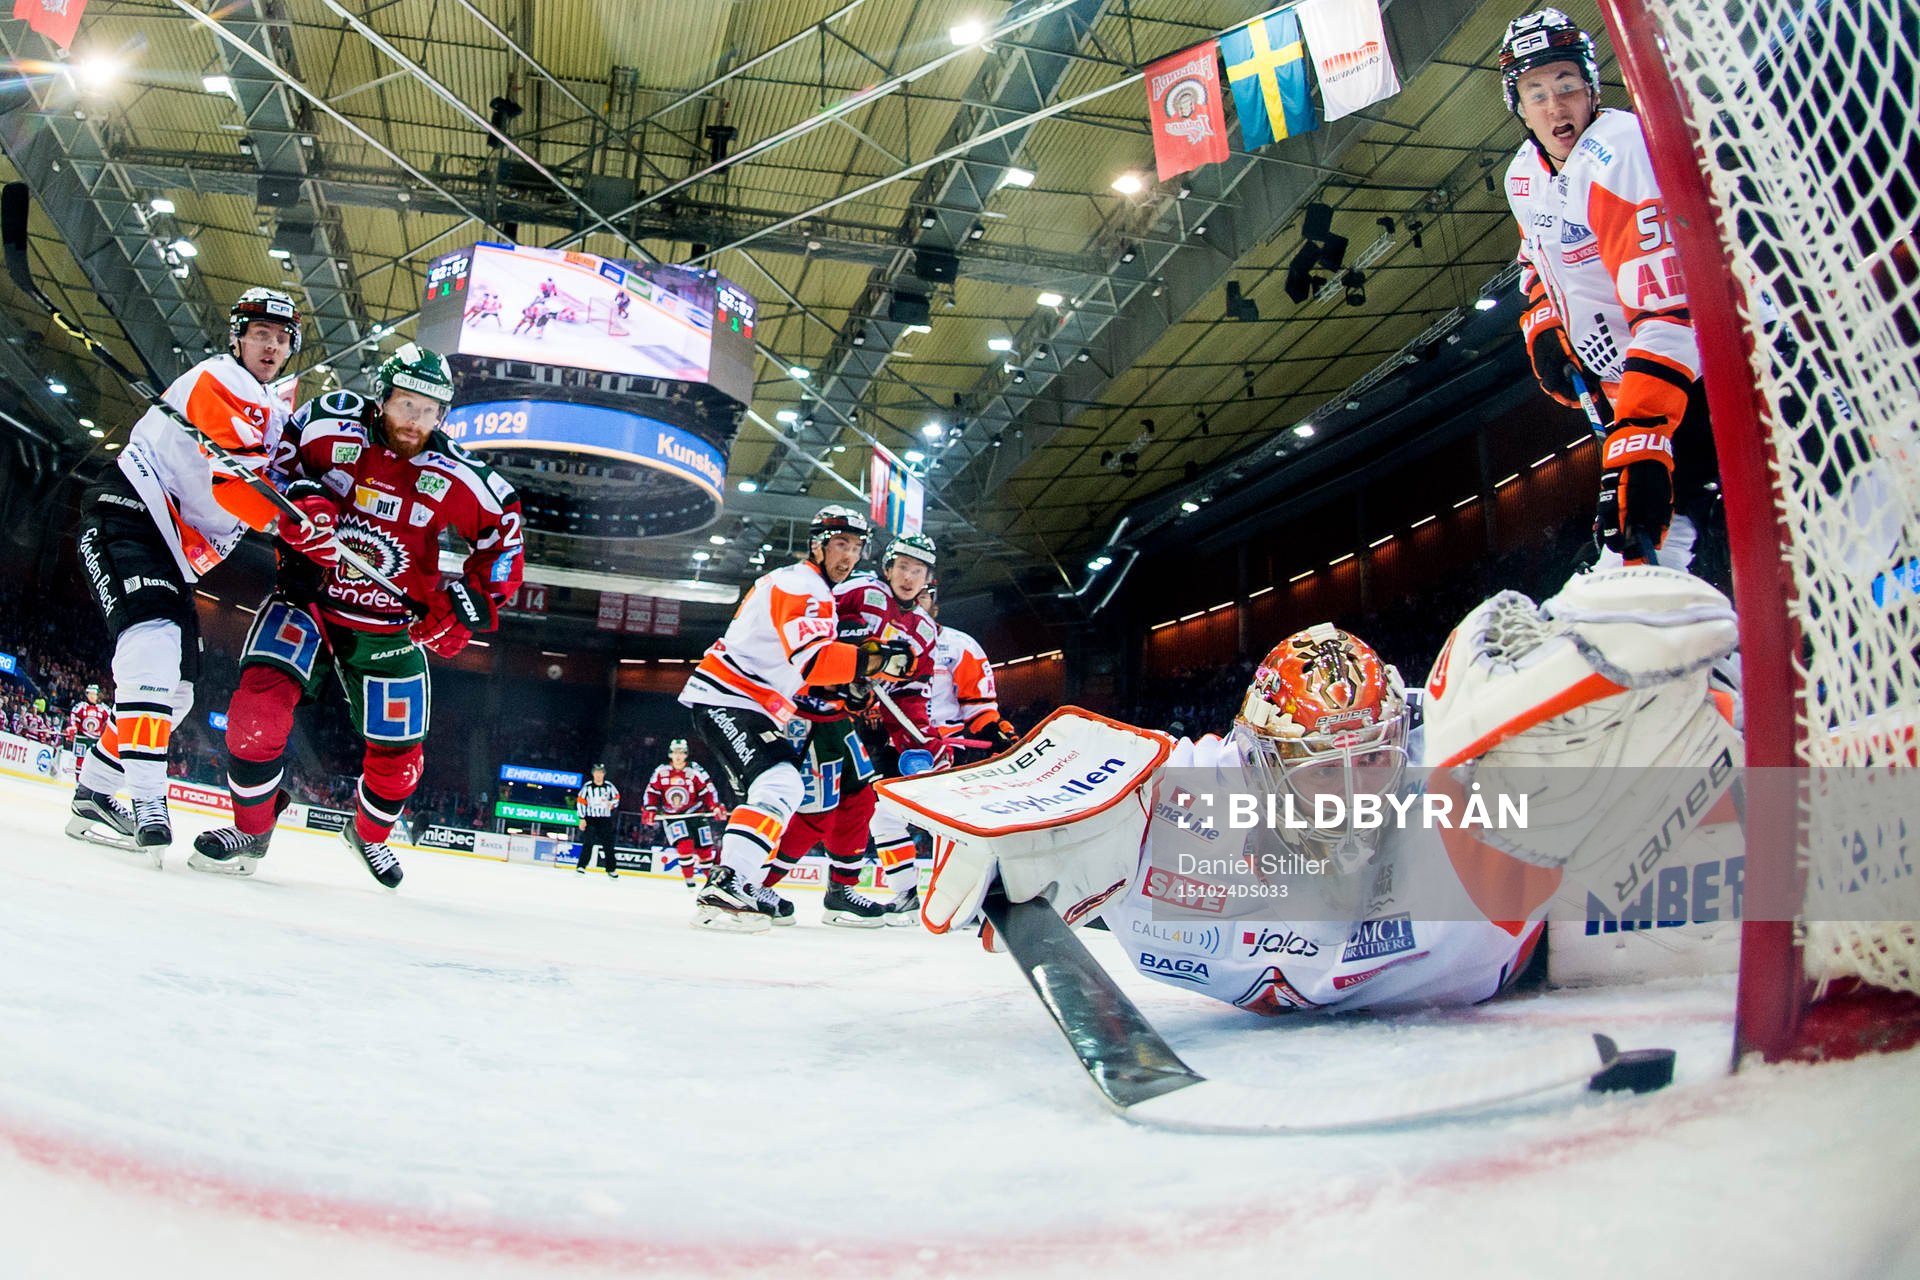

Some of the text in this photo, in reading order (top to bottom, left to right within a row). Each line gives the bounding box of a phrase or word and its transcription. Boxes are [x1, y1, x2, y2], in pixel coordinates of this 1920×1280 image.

[473, 411, 528, 436] 1929
[708, 707, 757, 767] Seden Rock
[506, 768, 578, 786] EHRENBORG
[502, 806, 577, 823] TV SOM DU VILL
[1147, 872, 1223, 911] SAVE
[1132, 919, 1193, 944] CALL4U
[1249, 927, 1319, 958] jalas
[1139, 952, 1210, 978] BAGA
